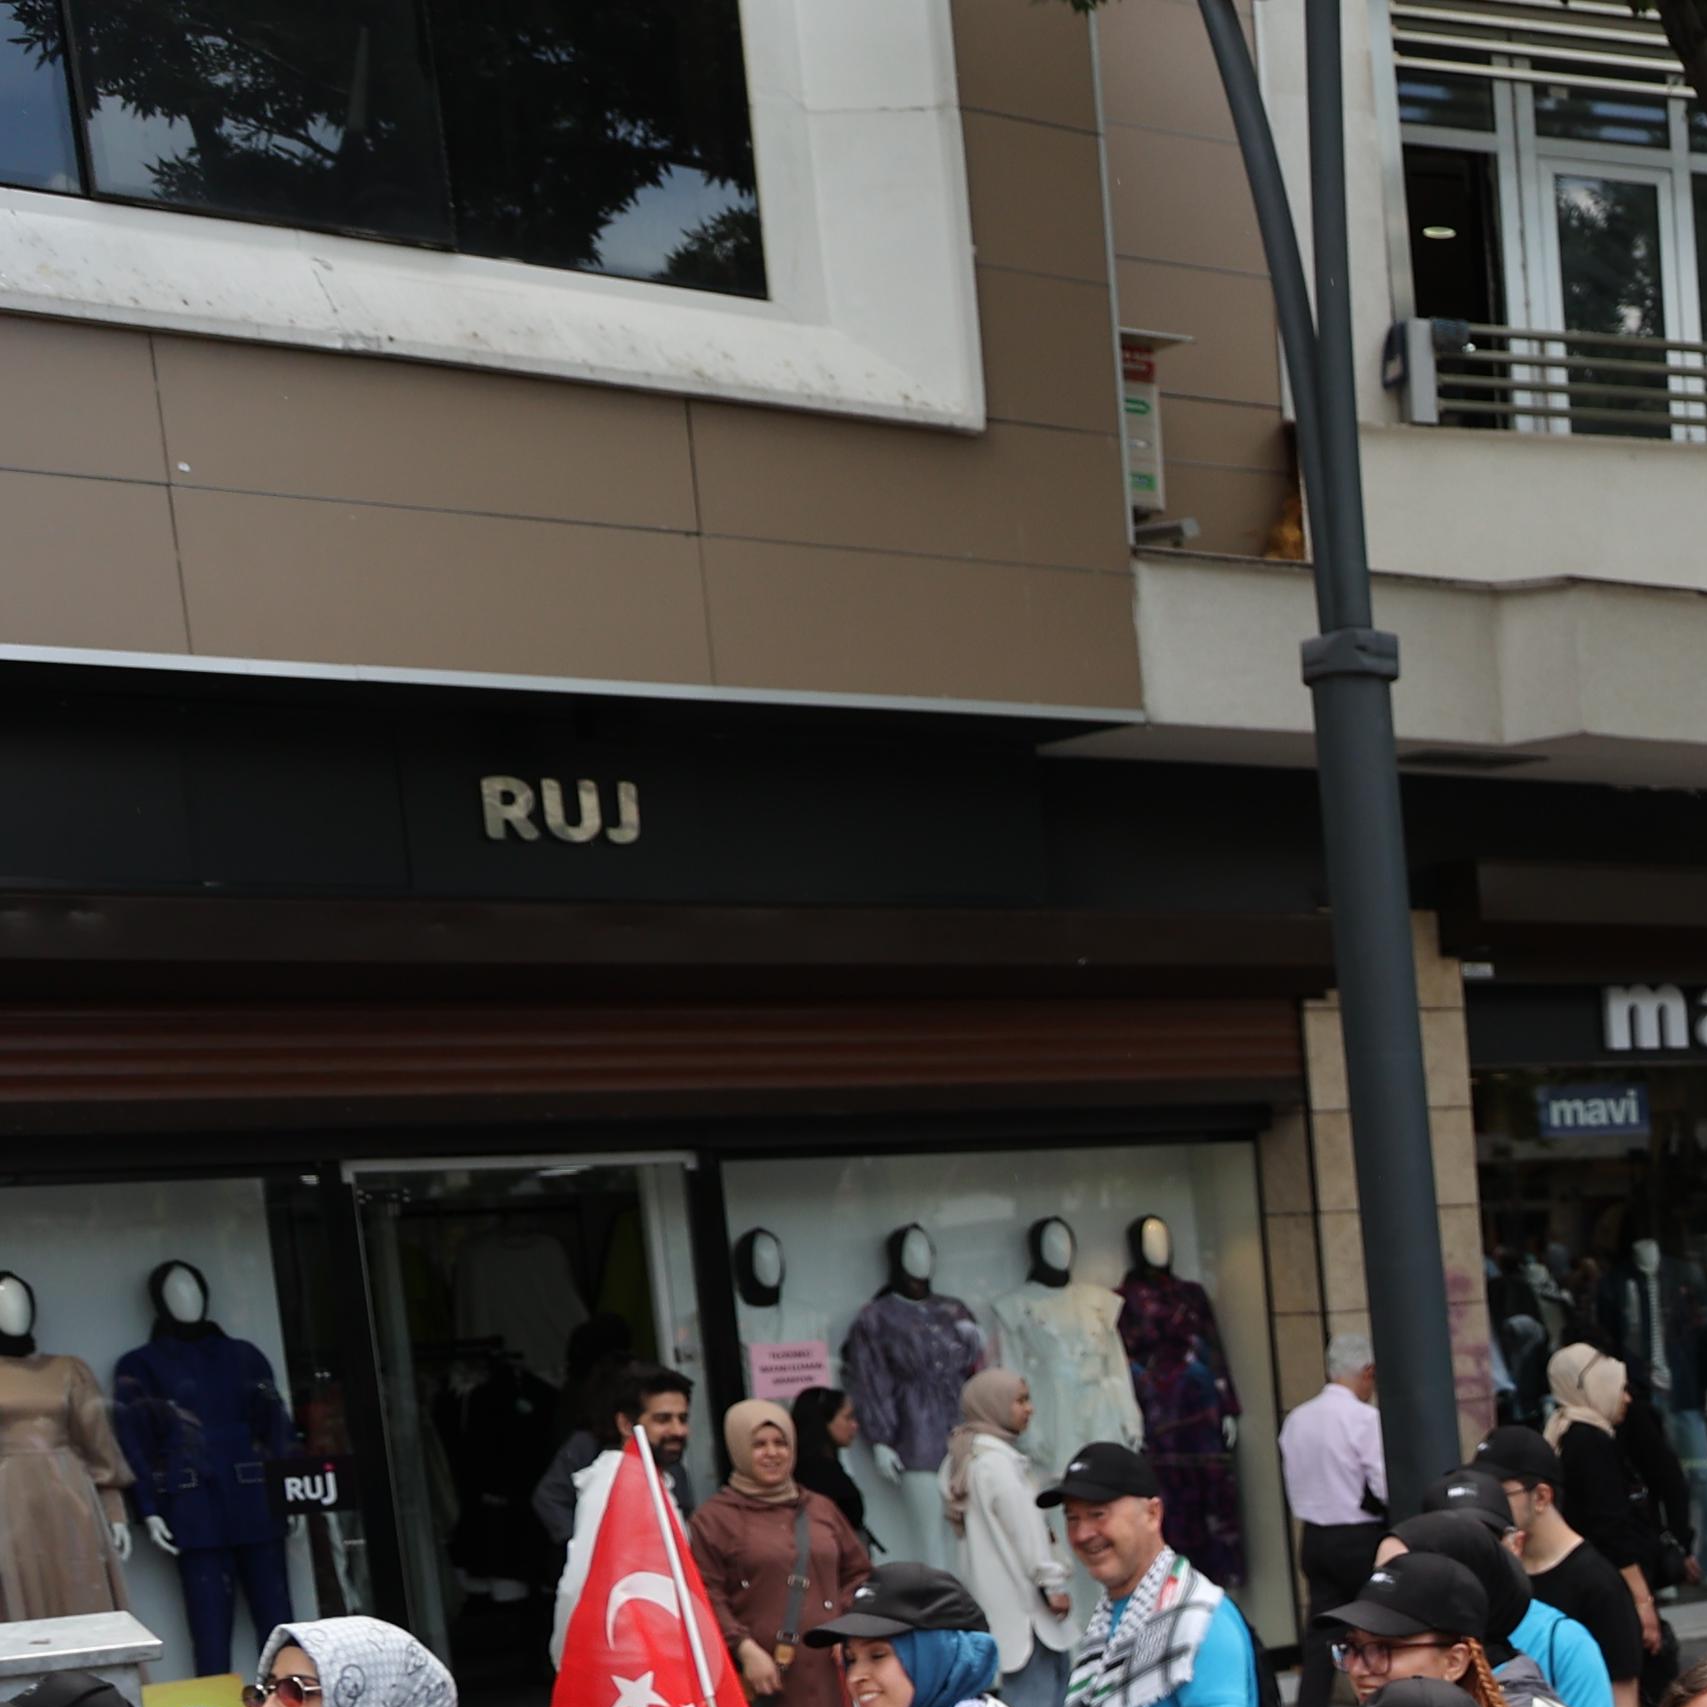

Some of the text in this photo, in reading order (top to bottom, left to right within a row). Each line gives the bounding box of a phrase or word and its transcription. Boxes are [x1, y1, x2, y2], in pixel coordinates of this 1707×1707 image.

[481, 776, 641, 845] RUJ
[1549, 1091, 1640, 1128] mavi
[284, 1463, 338, 1504] RUJ
